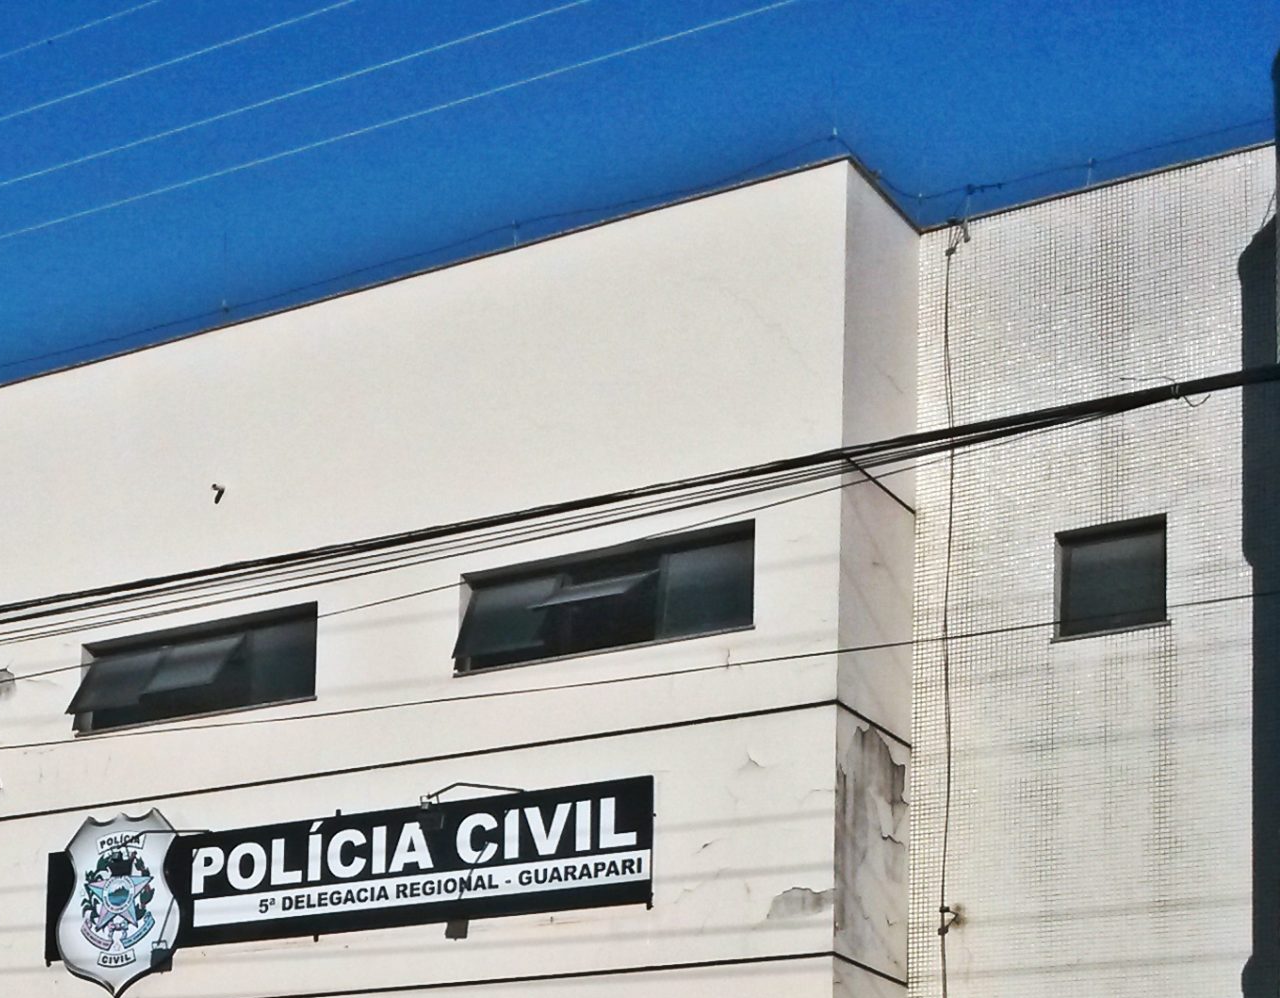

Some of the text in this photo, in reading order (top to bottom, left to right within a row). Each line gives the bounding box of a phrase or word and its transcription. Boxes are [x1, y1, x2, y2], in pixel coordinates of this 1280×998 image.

[191, 797, 637, 894] POLÍCIA CIVIL
[282, 885, 389, 911] DELEGACIA
[395, 873, 499, 899] REGIONAL
[518, 857, 643, 886] GUARAPARI
[102, 954, 131, 964] CIVIL
